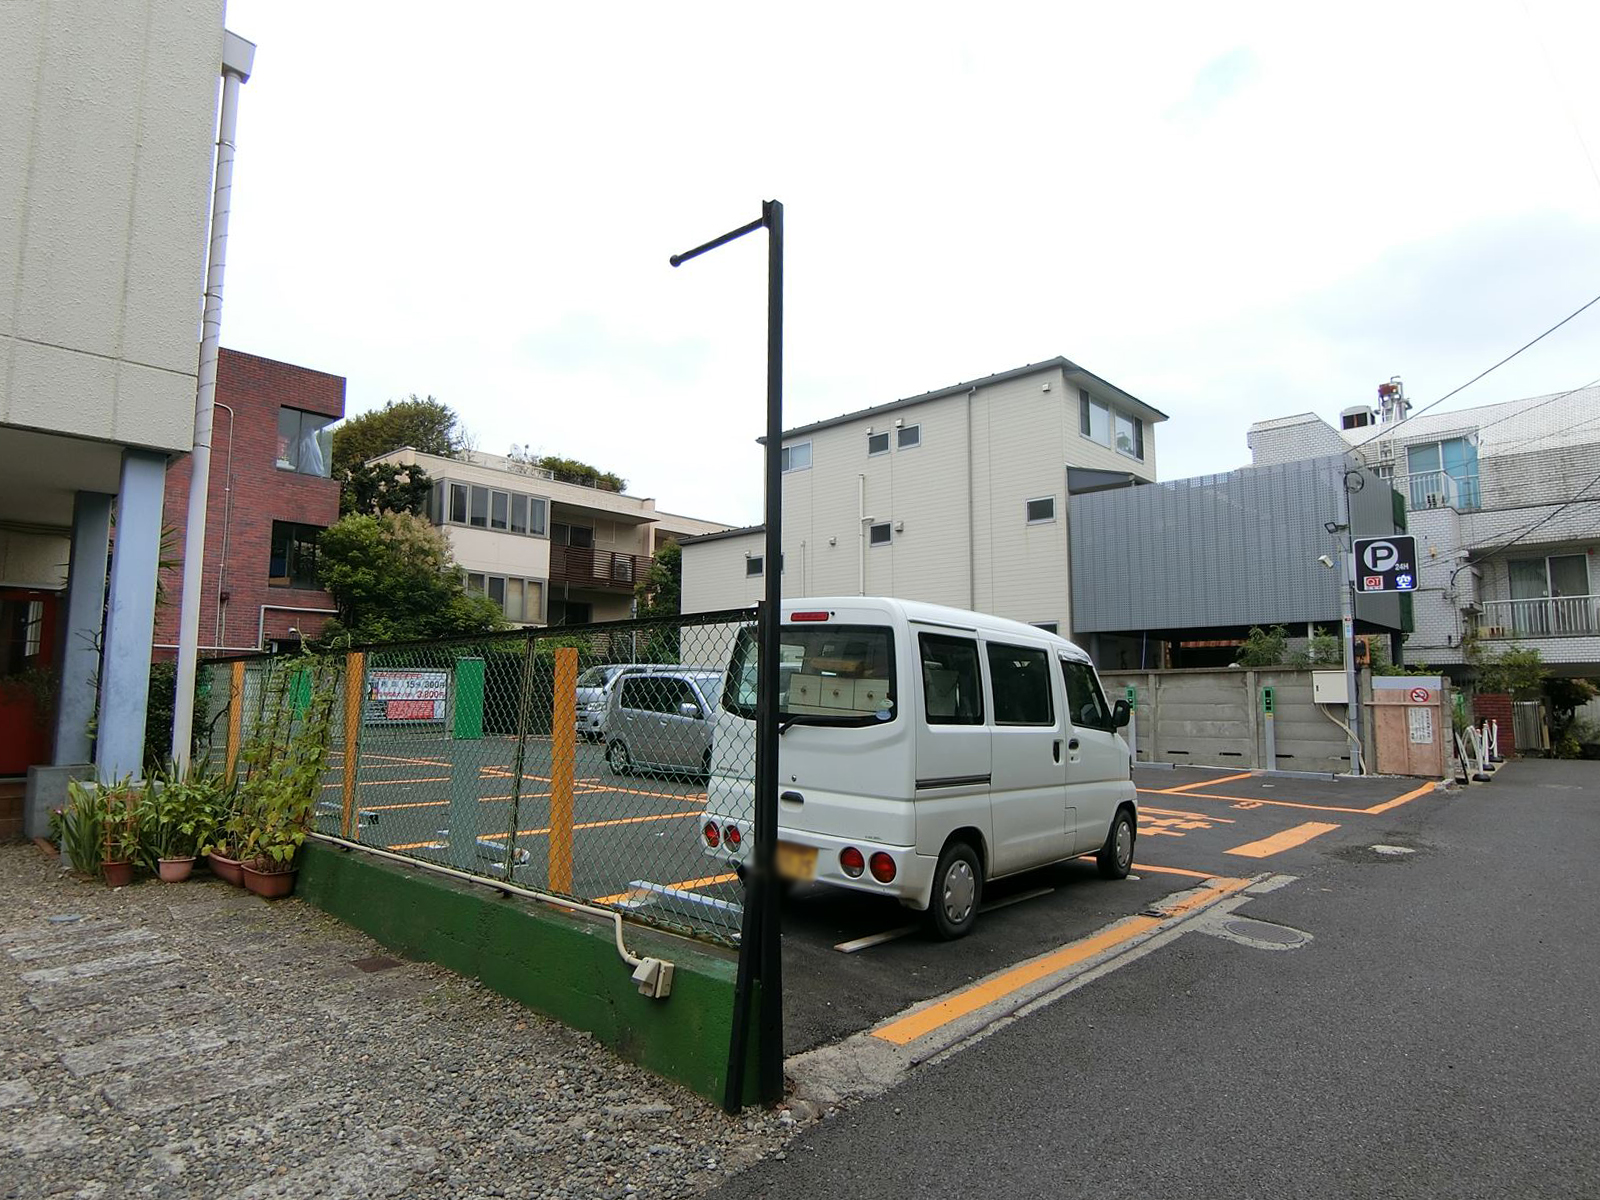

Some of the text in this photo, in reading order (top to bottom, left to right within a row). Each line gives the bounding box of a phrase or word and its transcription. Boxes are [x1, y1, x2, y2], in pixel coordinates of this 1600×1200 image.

[1370, 546, 1394, 568] P
[1394, 562, 1409, 571] 24H
[1396, 574, 1412, 589] 空
